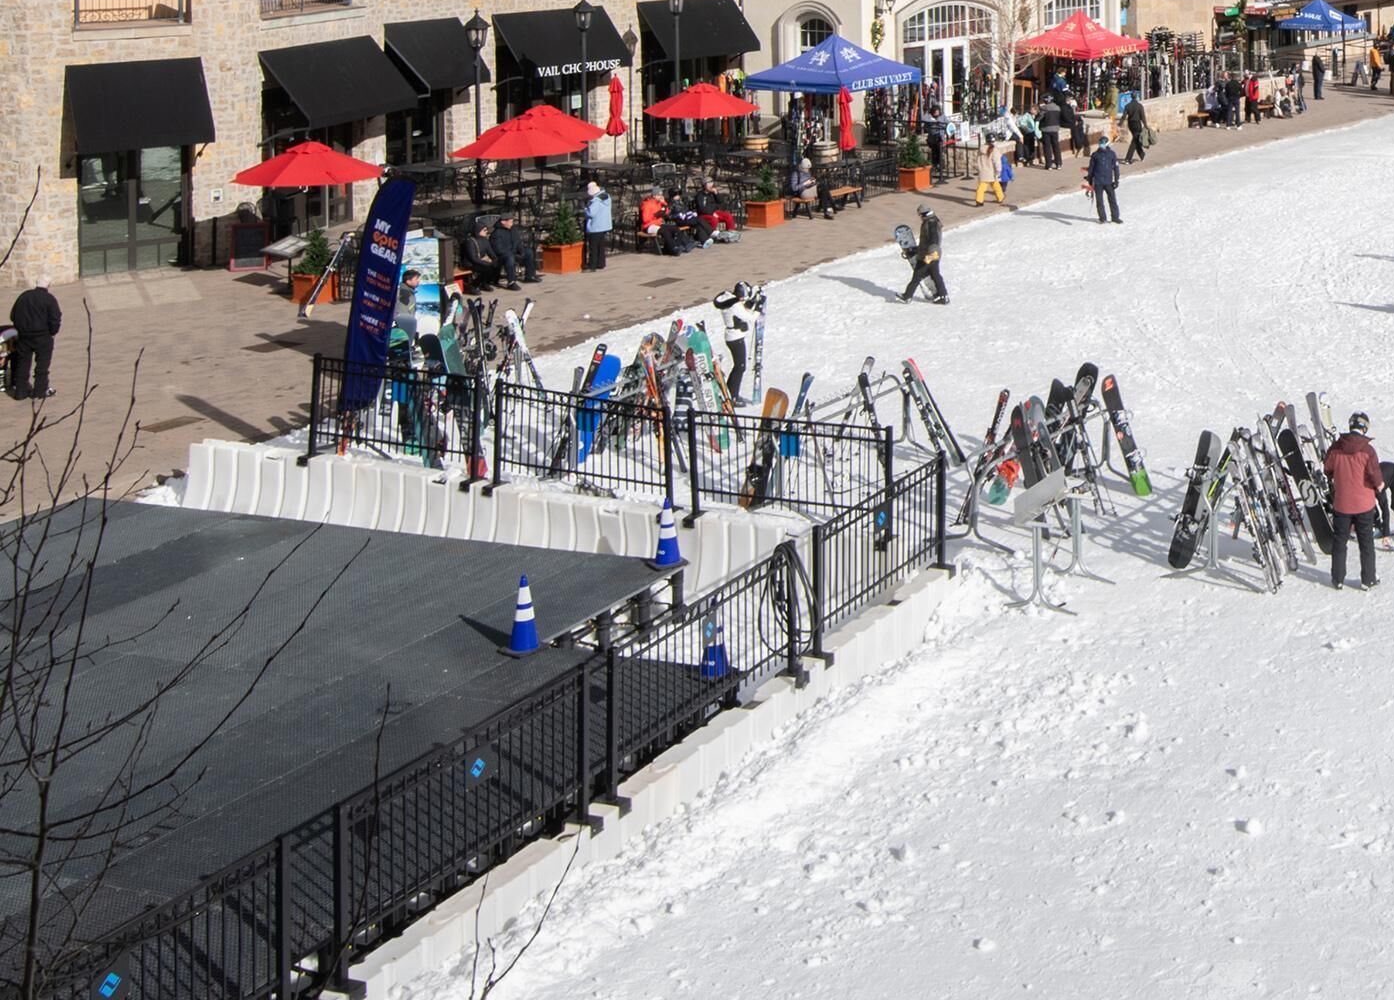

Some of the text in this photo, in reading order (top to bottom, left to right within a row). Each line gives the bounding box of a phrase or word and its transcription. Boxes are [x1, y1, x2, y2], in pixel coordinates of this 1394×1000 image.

[1042, 47, 1073, 57] VALET
[537, 65, 561, 77] VAIL
[852, 78, 873, 90] CLUB
[874, 75, 888, 87] SKI
[374, 219, 391, 234] MY
[373, 231, 399, 250] epic
[370, 243, 397, 264] GEAR
